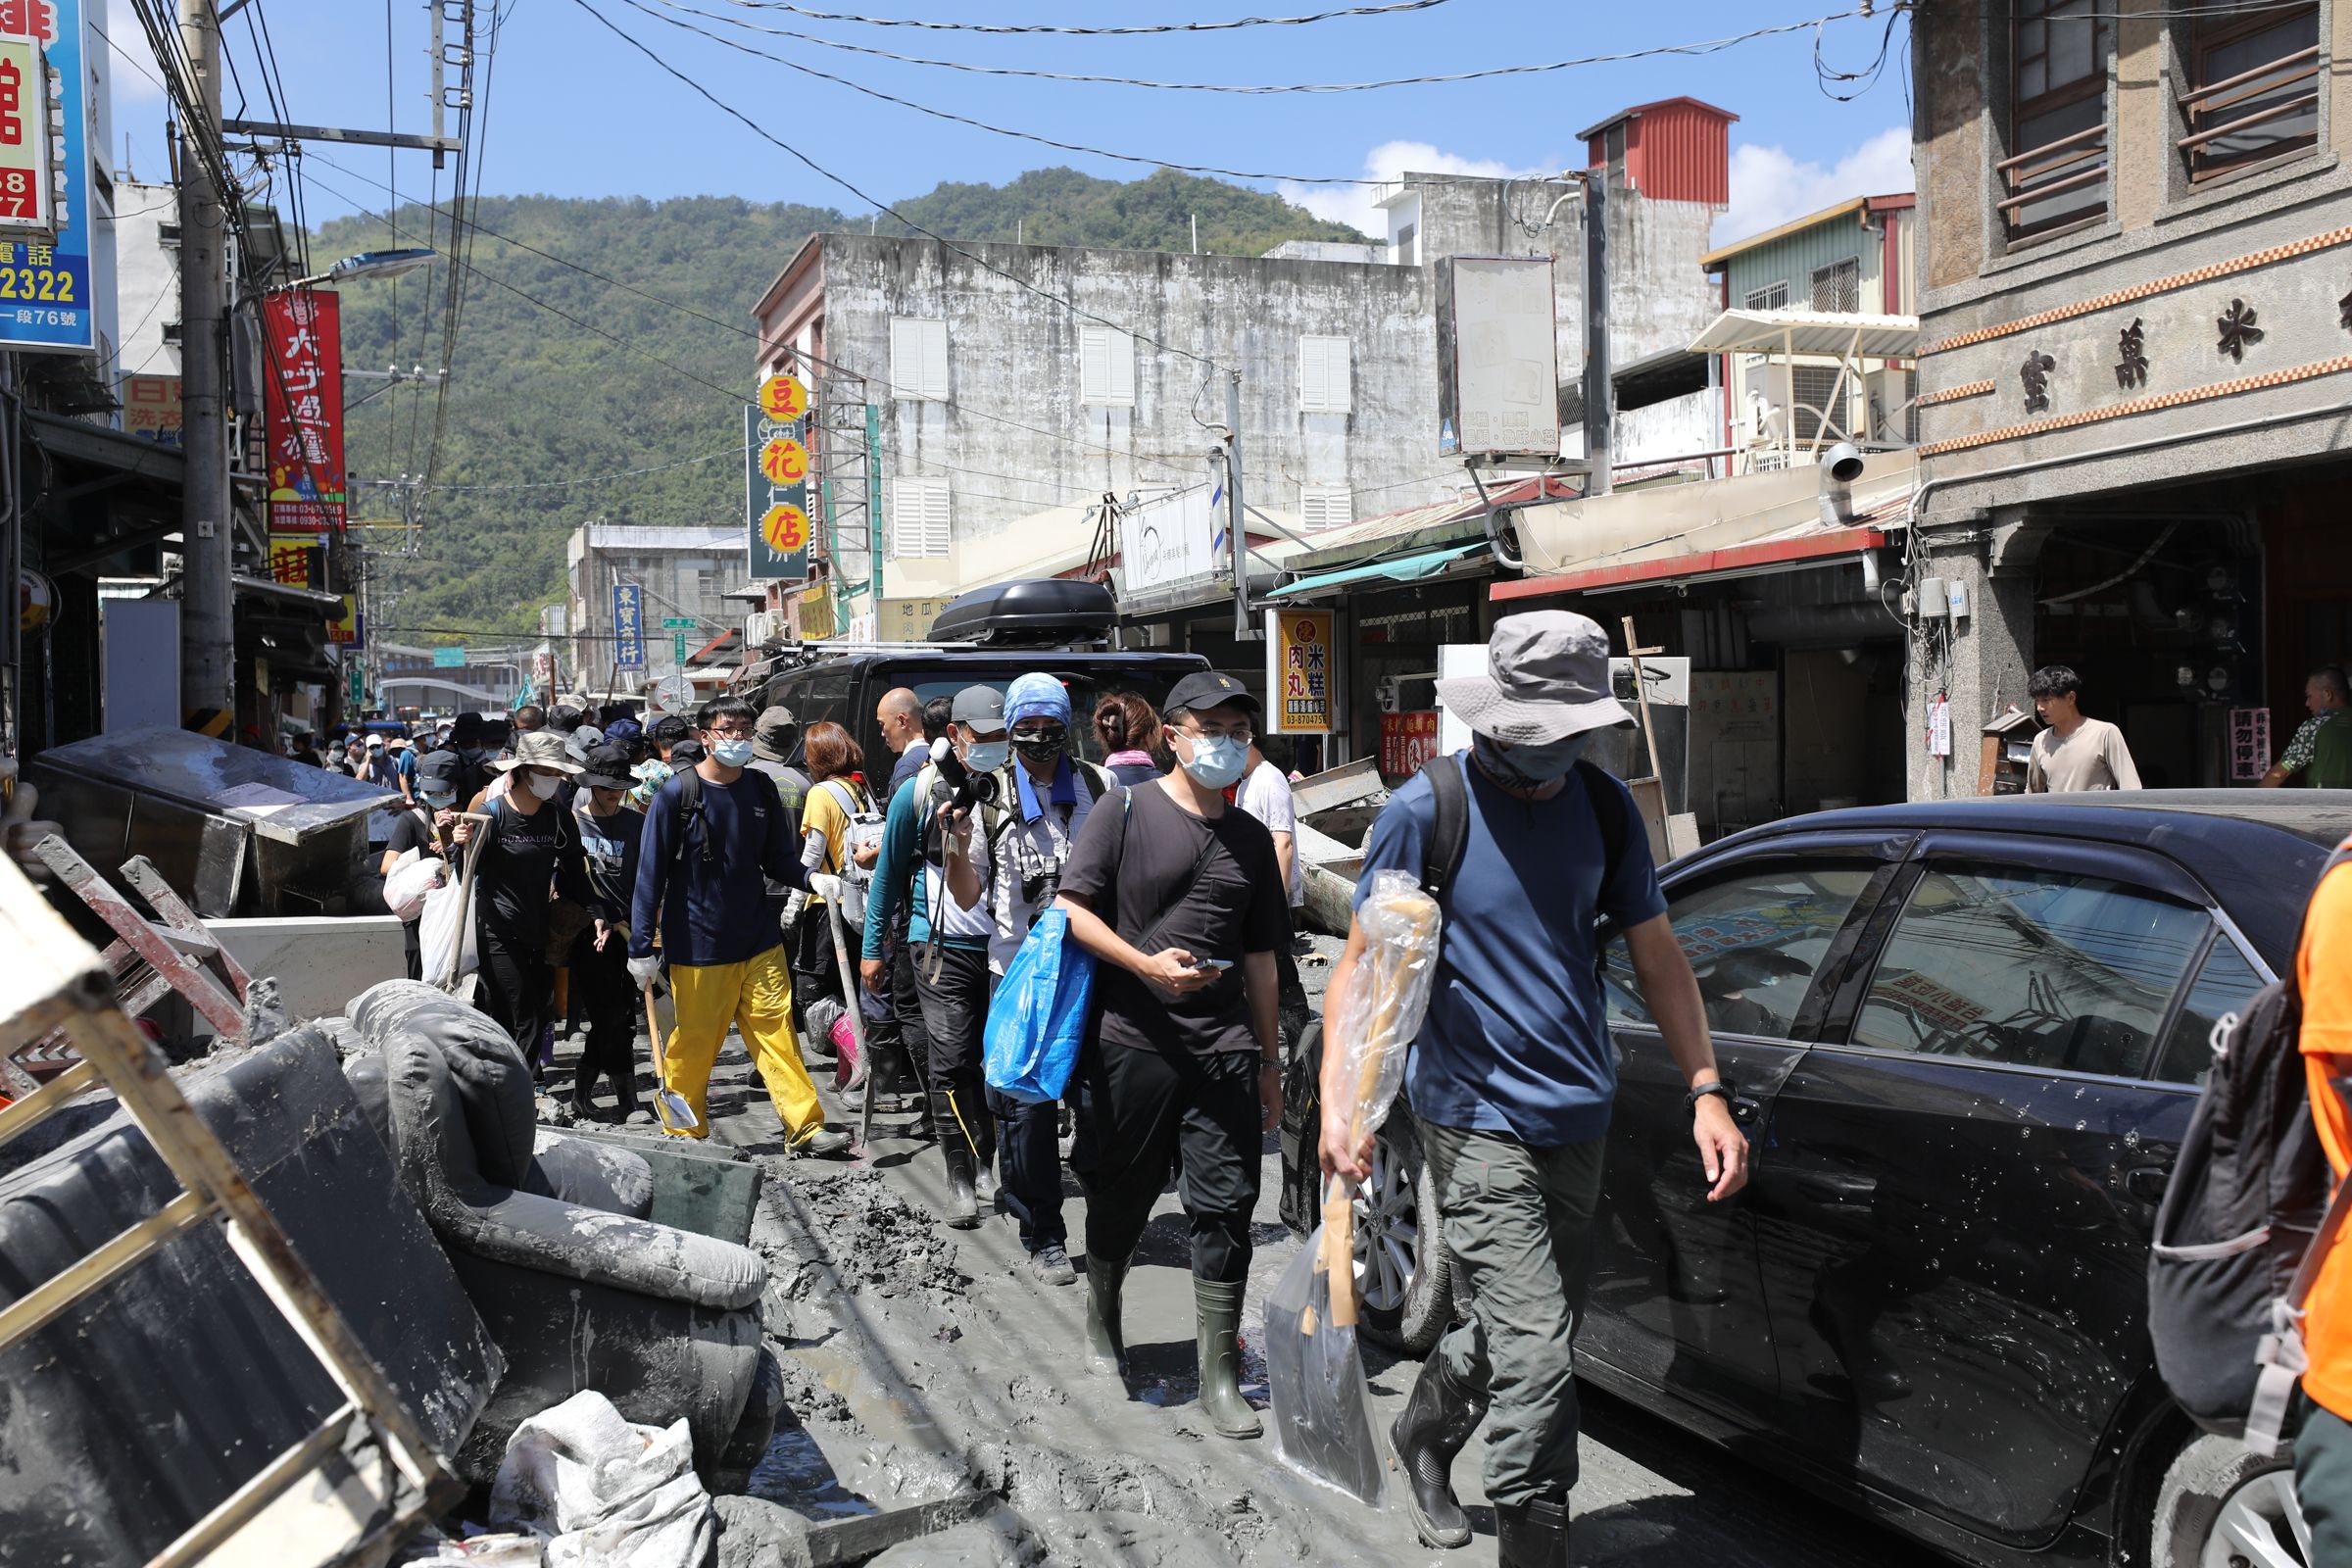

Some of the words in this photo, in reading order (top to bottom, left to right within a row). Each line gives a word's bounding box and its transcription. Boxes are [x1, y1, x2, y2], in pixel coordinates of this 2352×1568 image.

[0, 268, 74, 302] 2322
[765, 379, 804, 548] 豆花店
[617, 587, 640, 664] 東寶商行
[1287, 644, 1304, 698] 肉丸
[1307, 644, 1326, 698] 米糕
[2234, 710, 2254, 777] 請勿停車
